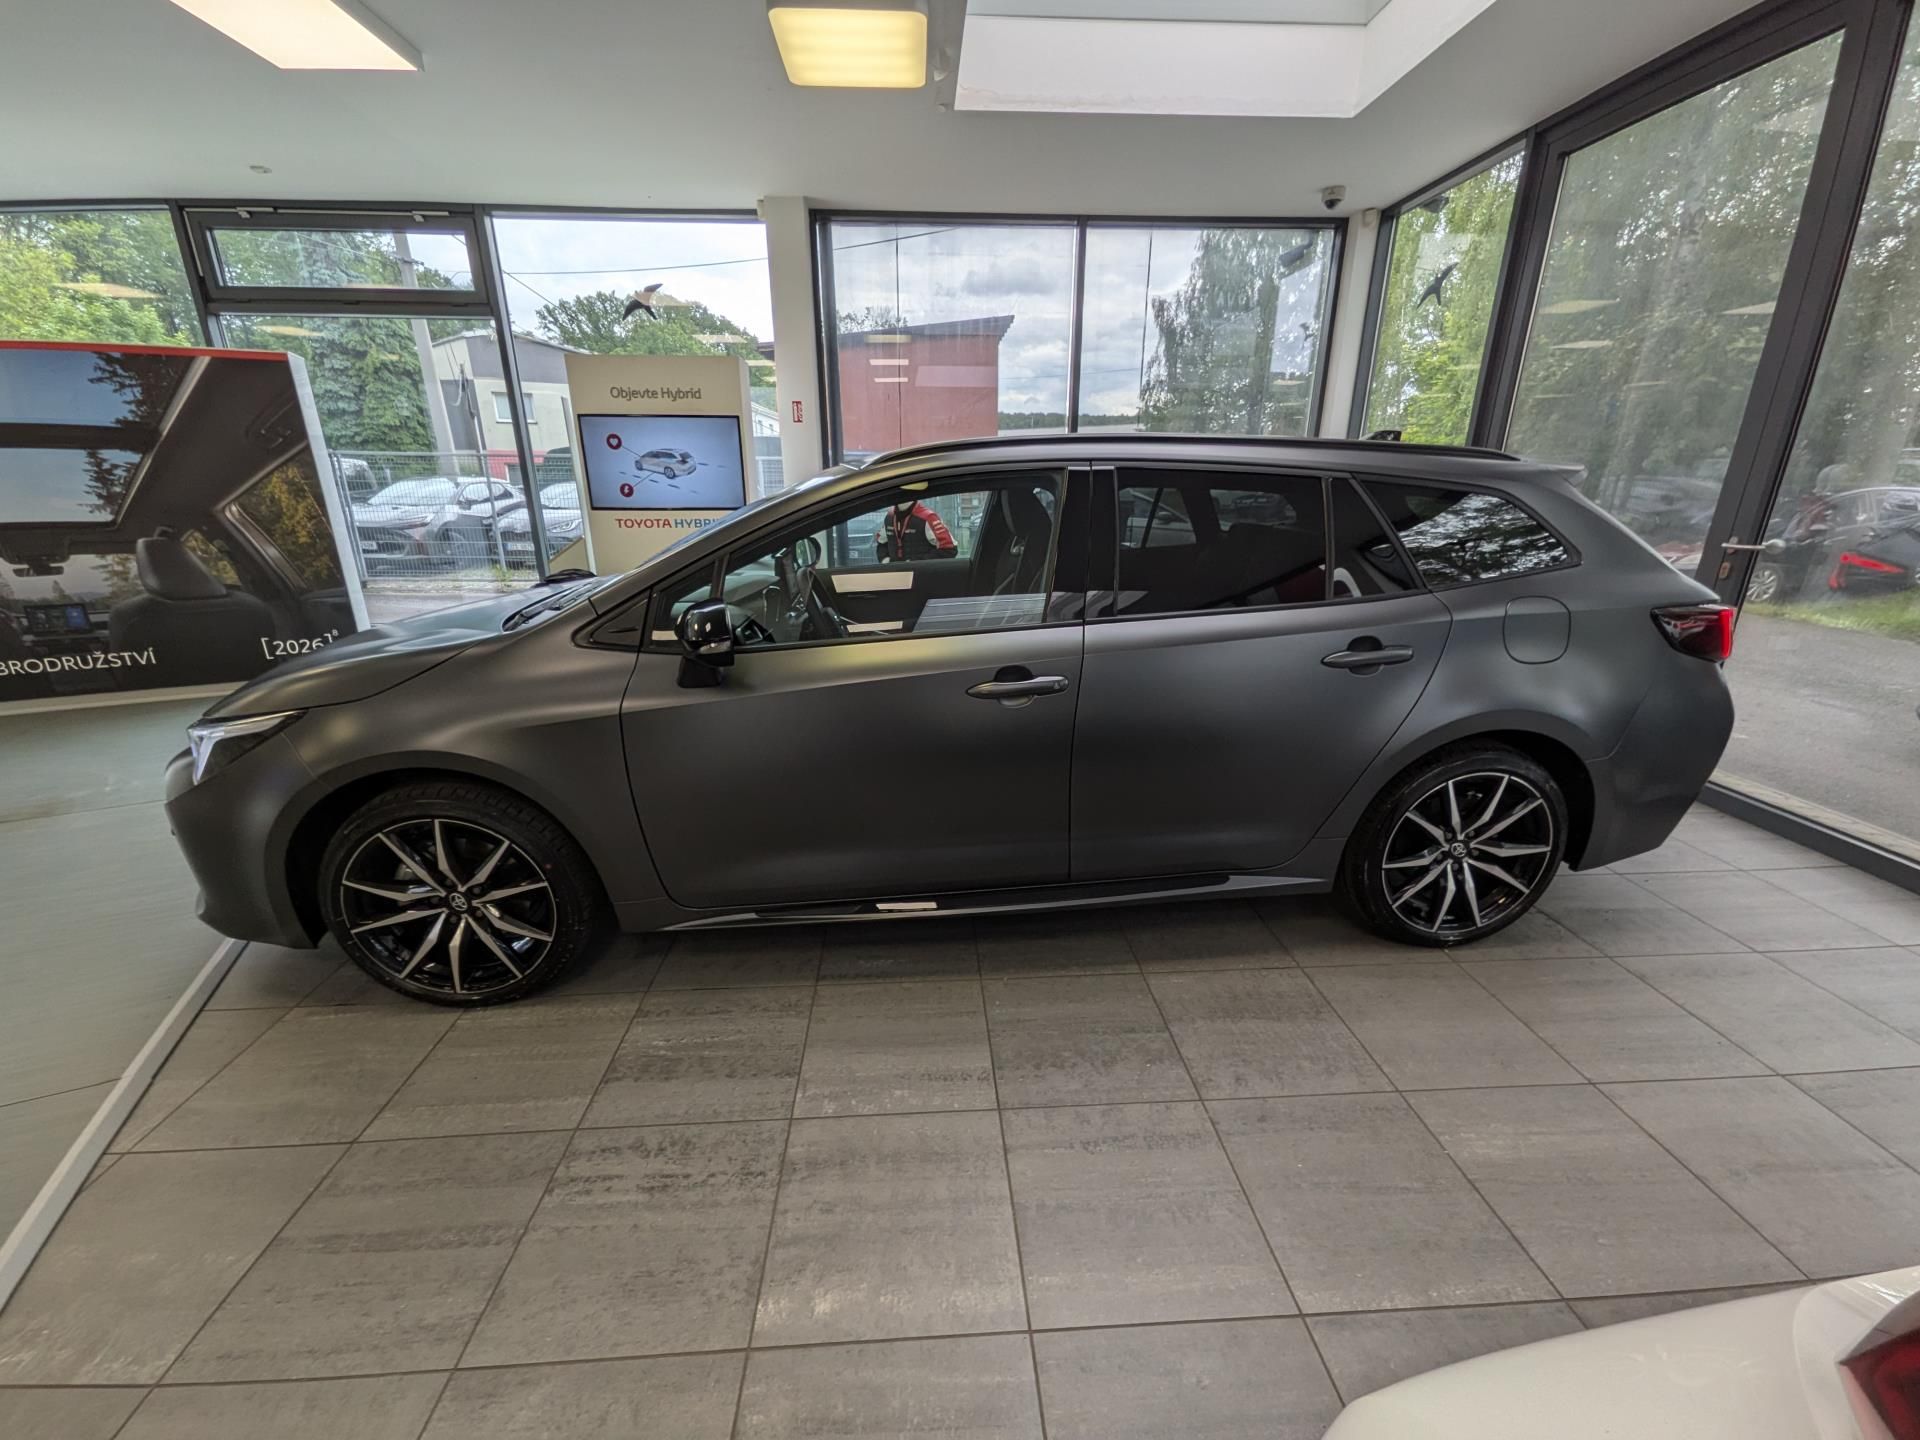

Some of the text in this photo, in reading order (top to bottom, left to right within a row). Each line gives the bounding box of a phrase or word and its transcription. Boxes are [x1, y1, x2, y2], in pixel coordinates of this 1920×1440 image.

[609, 386, 702, 402] Objevte Hybrid
[615, 518, 720, 529] TOYOTA HYBR
[0, 647, 157, 676] BRODRUŽSTVÍ
